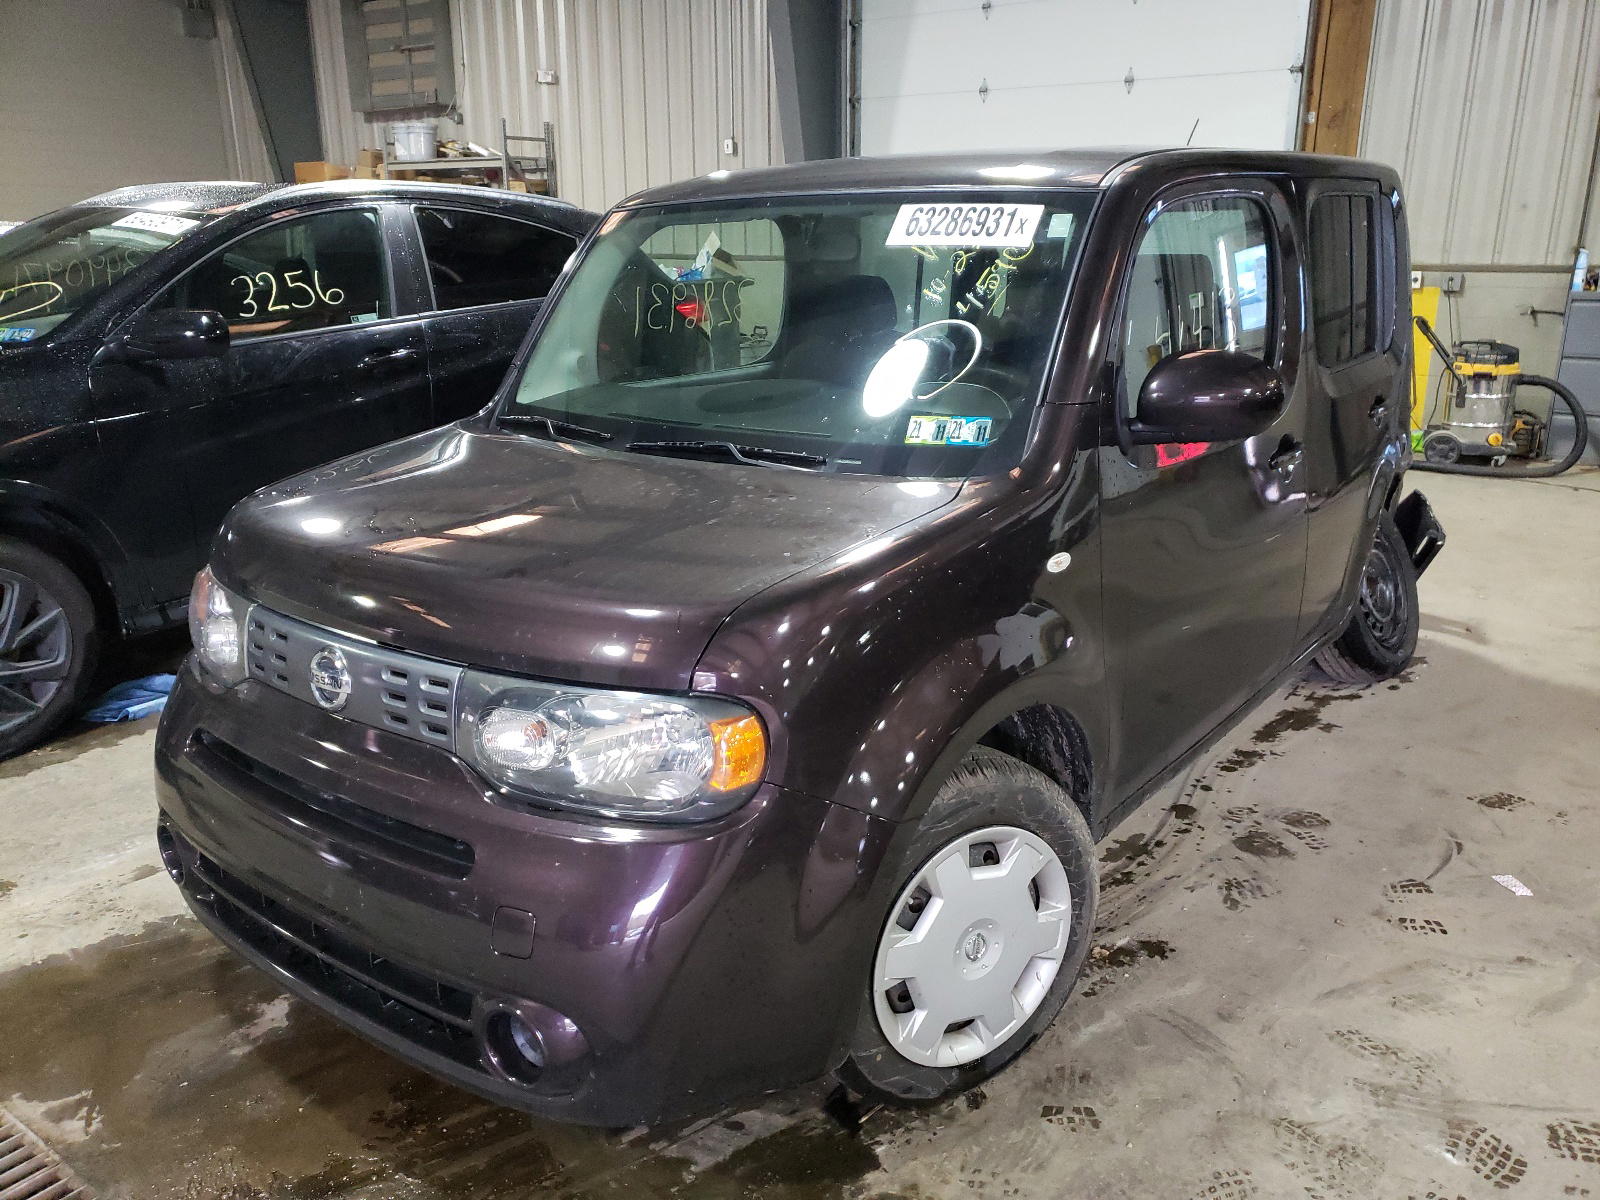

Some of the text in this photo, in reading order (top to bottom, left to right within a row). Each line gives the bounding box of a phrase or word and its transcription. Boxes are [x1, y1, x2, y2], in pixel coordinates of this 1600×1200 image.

[231, 270, 345, 318] 3256
[908, 420, 947, 441] 21 11
[950, 420, 988, 442] 21 11
